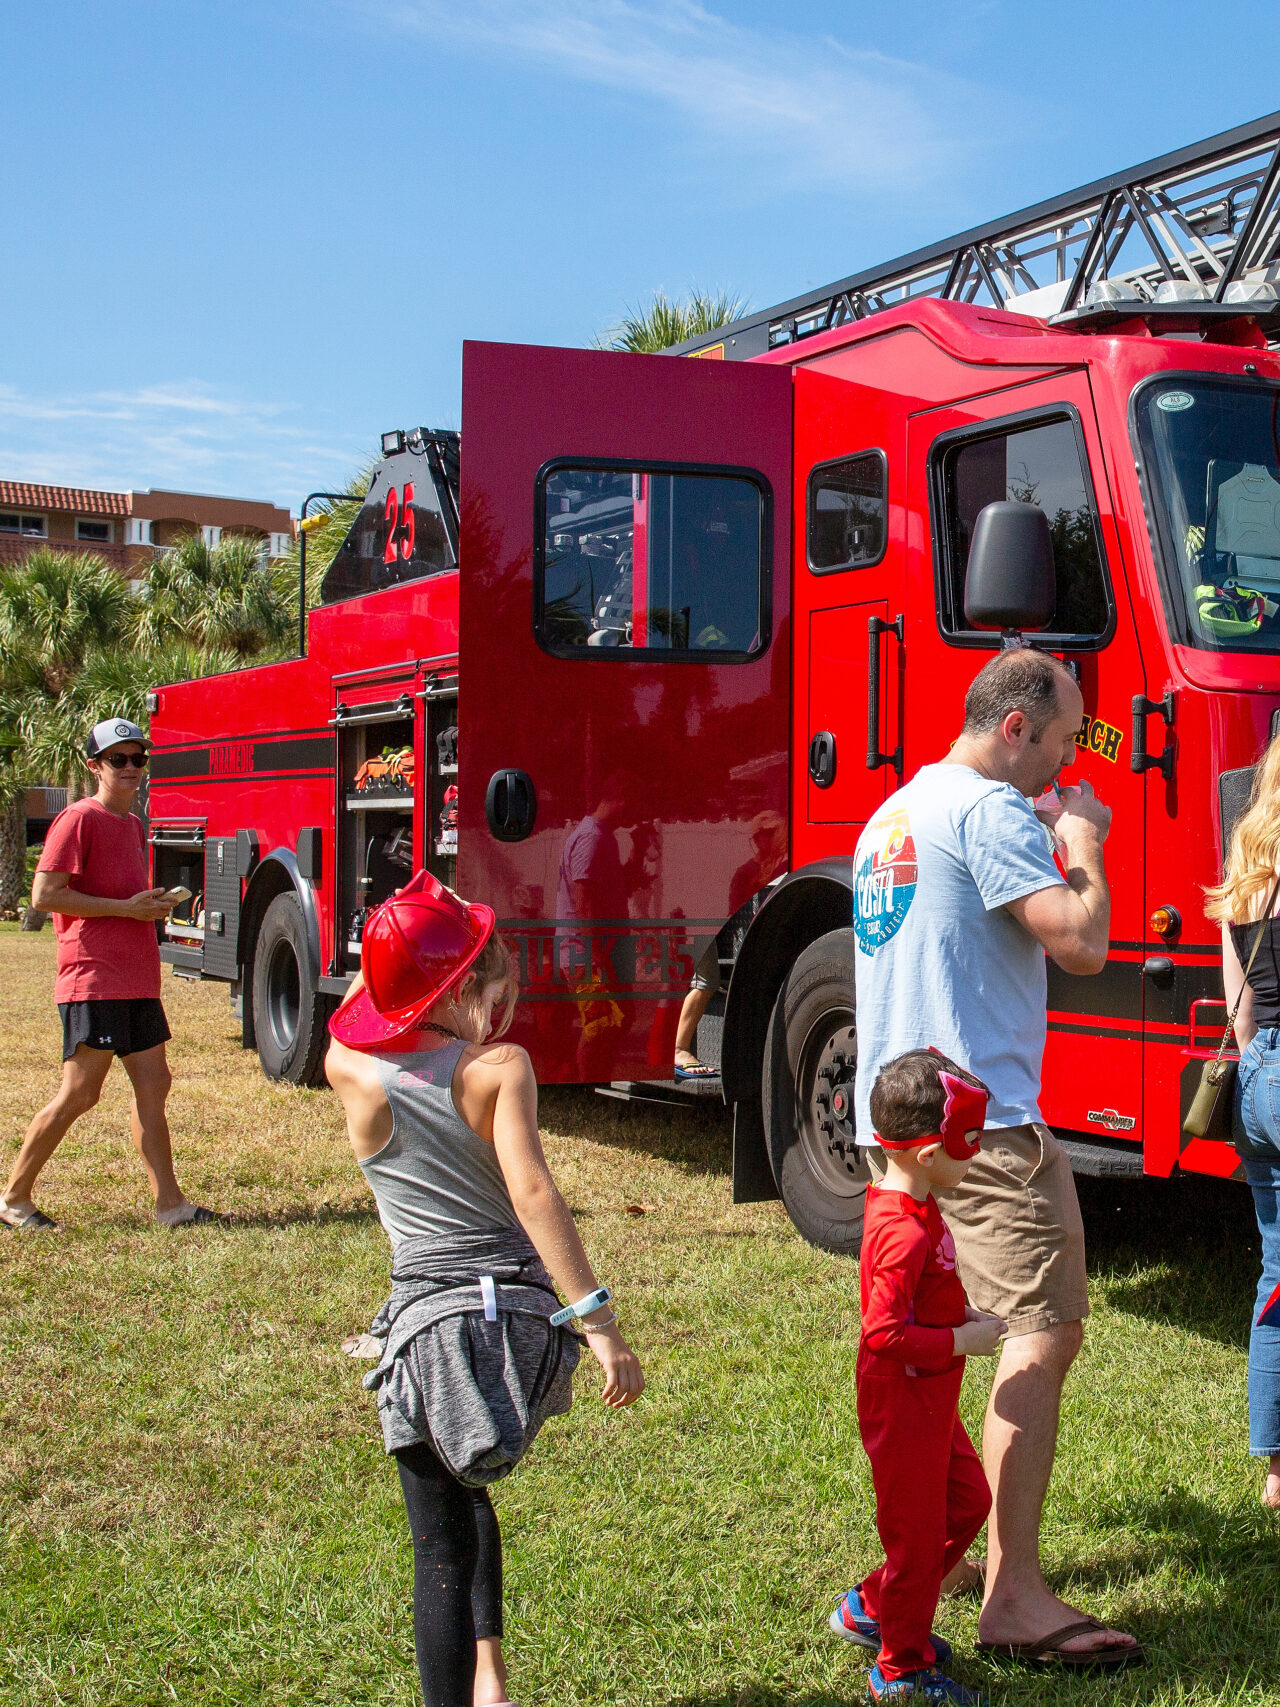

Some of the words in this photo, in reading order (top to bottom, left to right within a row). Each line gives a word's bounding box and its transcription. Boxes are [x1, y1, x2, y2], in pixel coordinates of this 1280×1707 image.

[385, 481, 415, 564] 25
[209, 744, 254, 775] PARAMEDIC
[1074, 714, 1123, 763] ACH
[857, 868, 896, 920] COSTA
[503, 937, 619, 984] RUCK
[636, 936, 695, 983] 25
